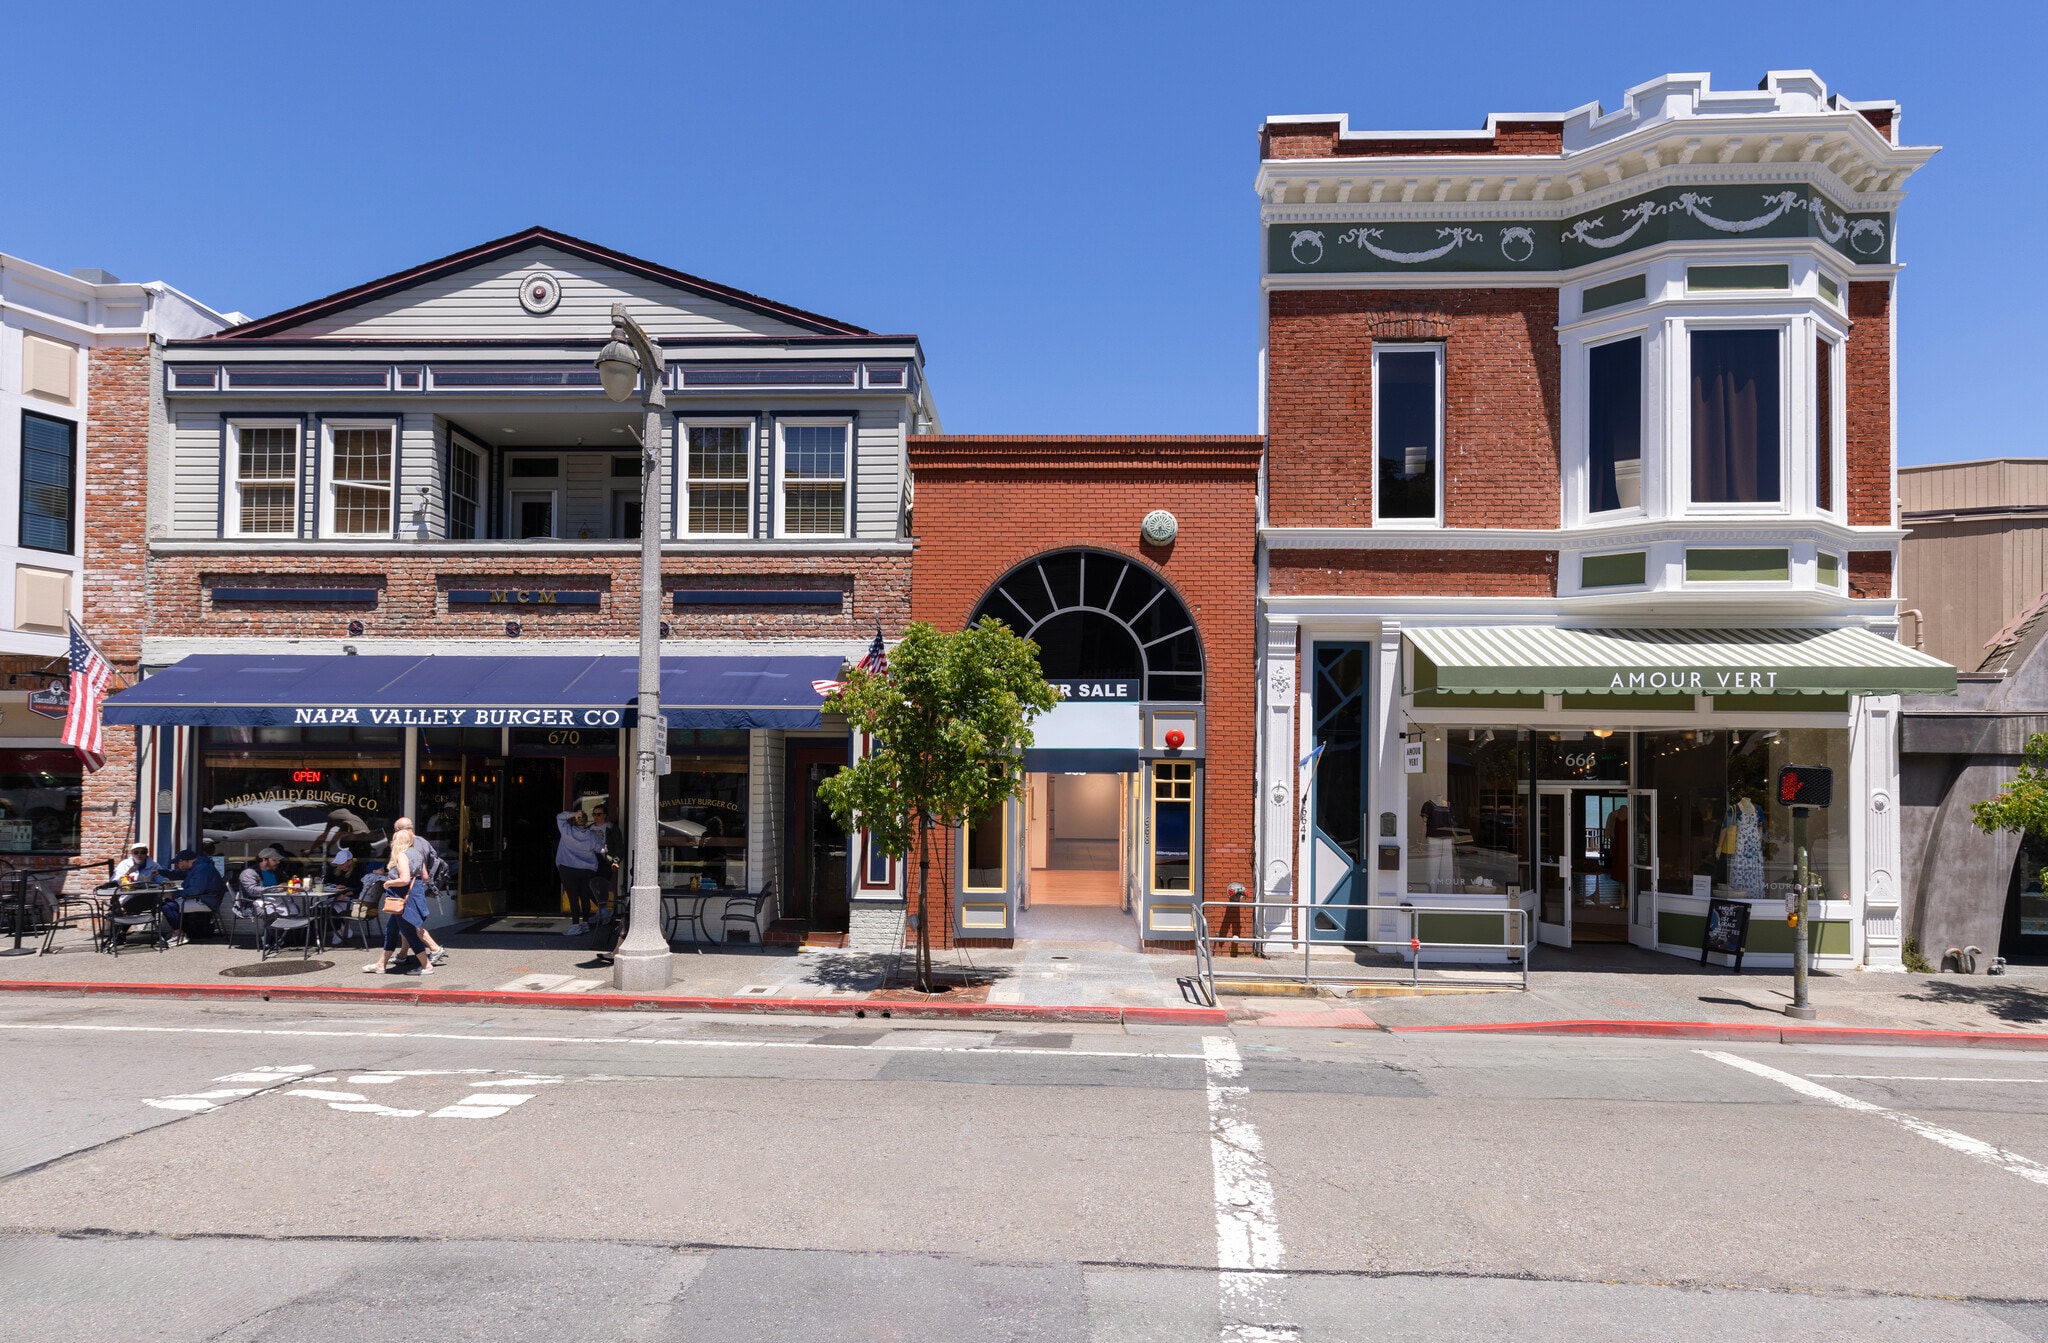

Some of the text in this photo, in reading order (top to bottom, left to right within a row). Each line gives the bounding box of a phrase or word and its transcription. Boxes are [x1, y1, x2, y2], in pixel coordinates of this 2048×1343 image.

[1610, 672, 1777, 688] AMOUR VERT
[1078, 684, 1128, 697] SALE
[294, 708, 620, 726] NAPA VALLEY BURGER CO
[548, 730, 580, 744] 670
[1406, 747, 1421, 756] AMOUR
[1408, 757, 1419, 766] VERT
[1565, 753, 1596, 767] 666
[292, 771, 321, 783] OPEN
[225, 789, 379, 812] NAPA VALLEY BURGER CO.
[658, 800, 672, 808] APA
[671, 798, 697, 806] VALLEY
[697, 798, 726, 808] BURGER
[726, 802, 739, 812] CO.
